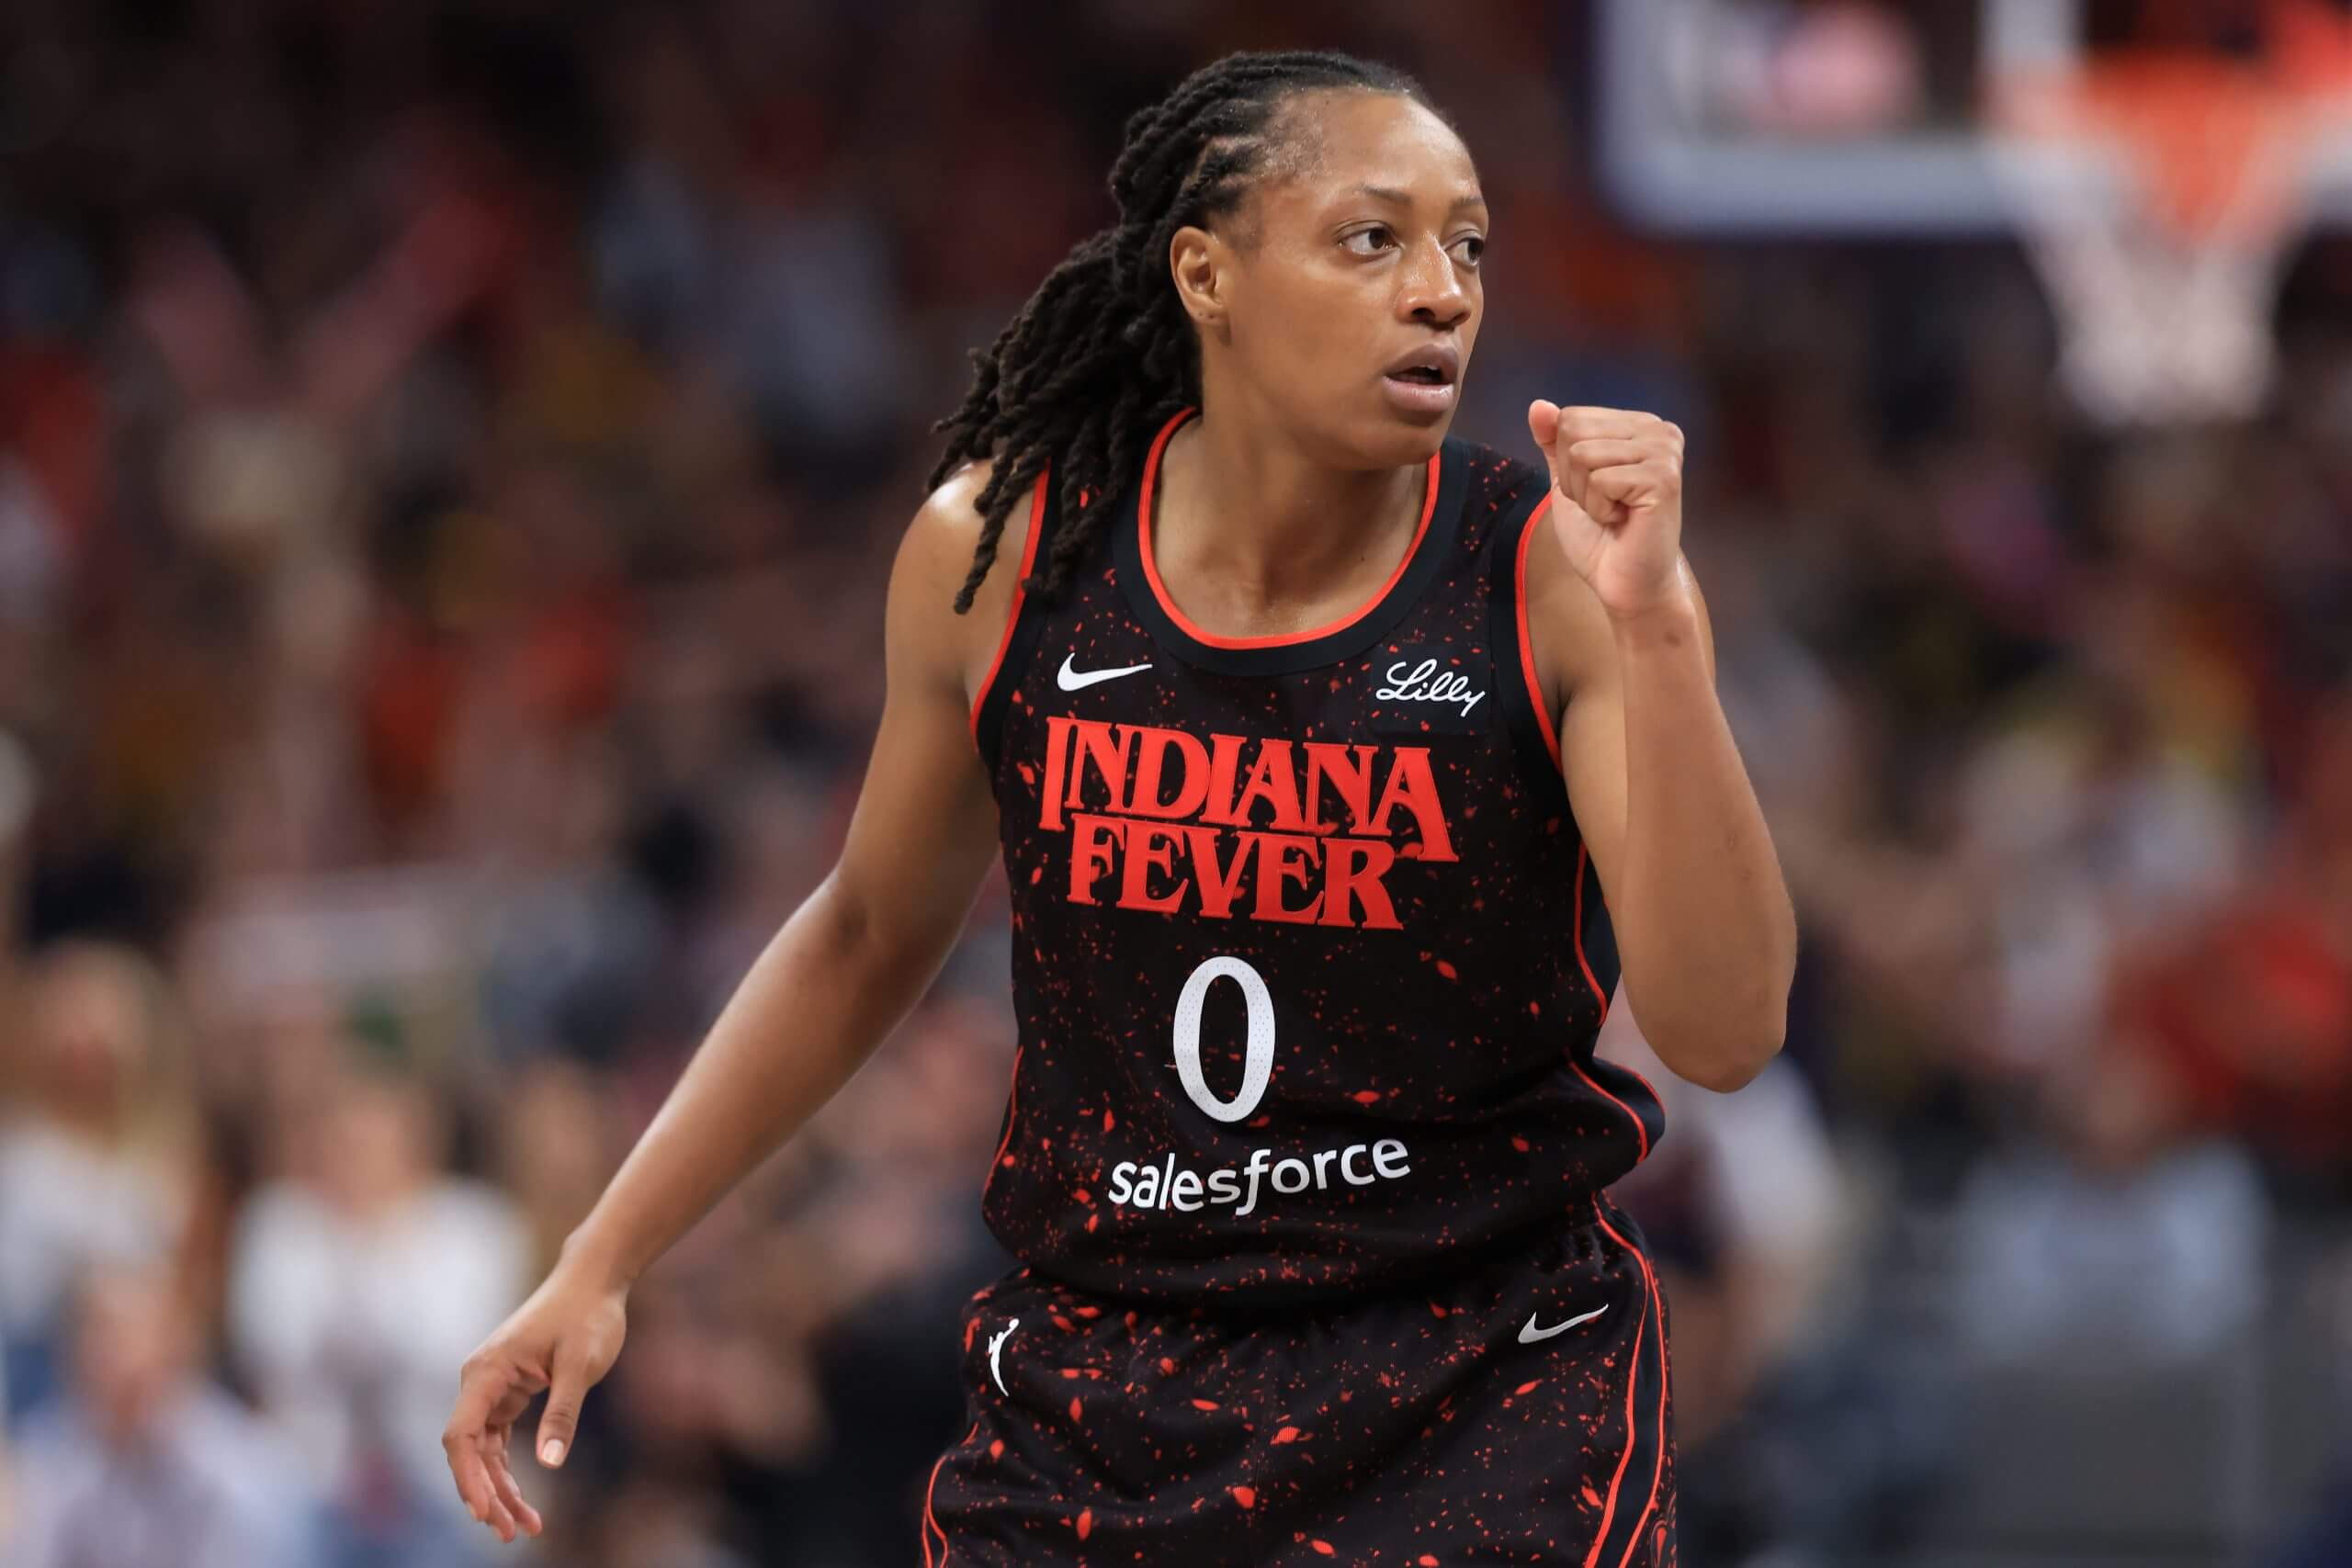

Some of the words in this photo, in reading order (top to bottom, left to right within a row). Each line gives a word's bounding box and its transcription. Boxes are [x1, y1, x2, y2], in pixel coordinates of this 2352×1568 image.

[1375, 658, 1486, 717] Lilly
[1038, 716, 1459, 863] INDIANA
[1067, 814, 1403, 930] FEVER
[1172, 955, 1276, 1122] 0
[1108, 1138, 1411, 1216] salesforce
